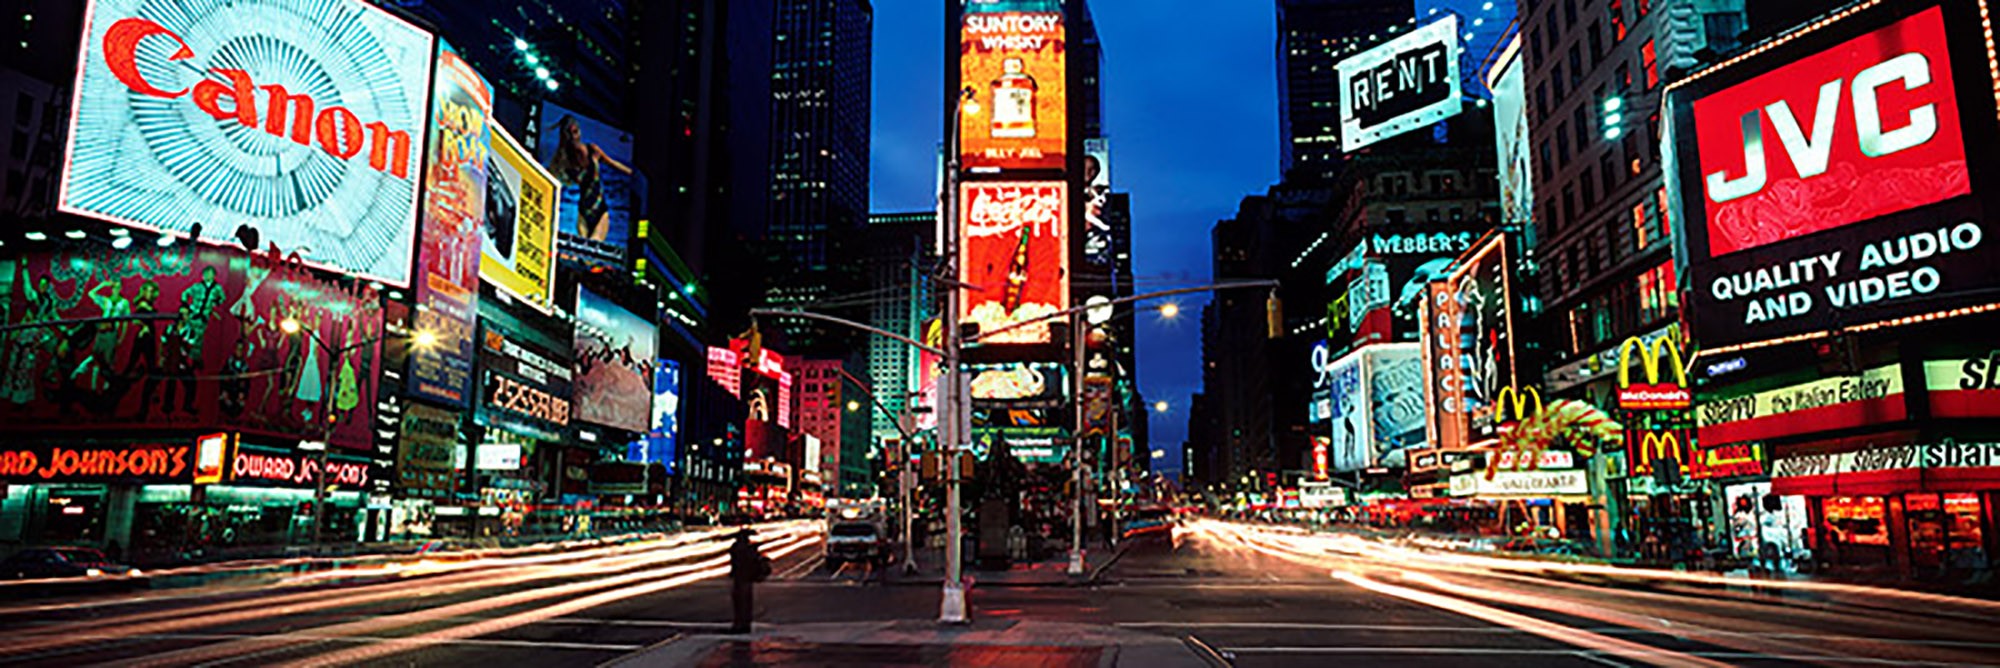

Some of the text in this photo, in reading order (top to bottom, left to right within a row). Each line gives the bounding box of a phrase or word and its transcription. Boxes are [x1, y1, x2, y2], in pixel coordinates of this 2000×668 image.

[966, 14, 1059, 34] SUNTORY
[981, 35, 1044, 50] WHISKY
[1353, 50, 1441, 111] RENT
[102, 16, 412, 180] Canon
[1706, 52, 1938, 204] JVC
[1372, 232, 1471, 254] WEBBER'S
[1711, 222, 1983, 300] QUALITY AUDIO
[1744, 266, 1941, 324] AND VIDEO
[1620, 389, 1690, 401] McDonald's
[1795, 386, 1836, 409] Italian
[1840, 378, 1891, 403] Eatery
[38, 447, 189, 479] JOHNSON'S
